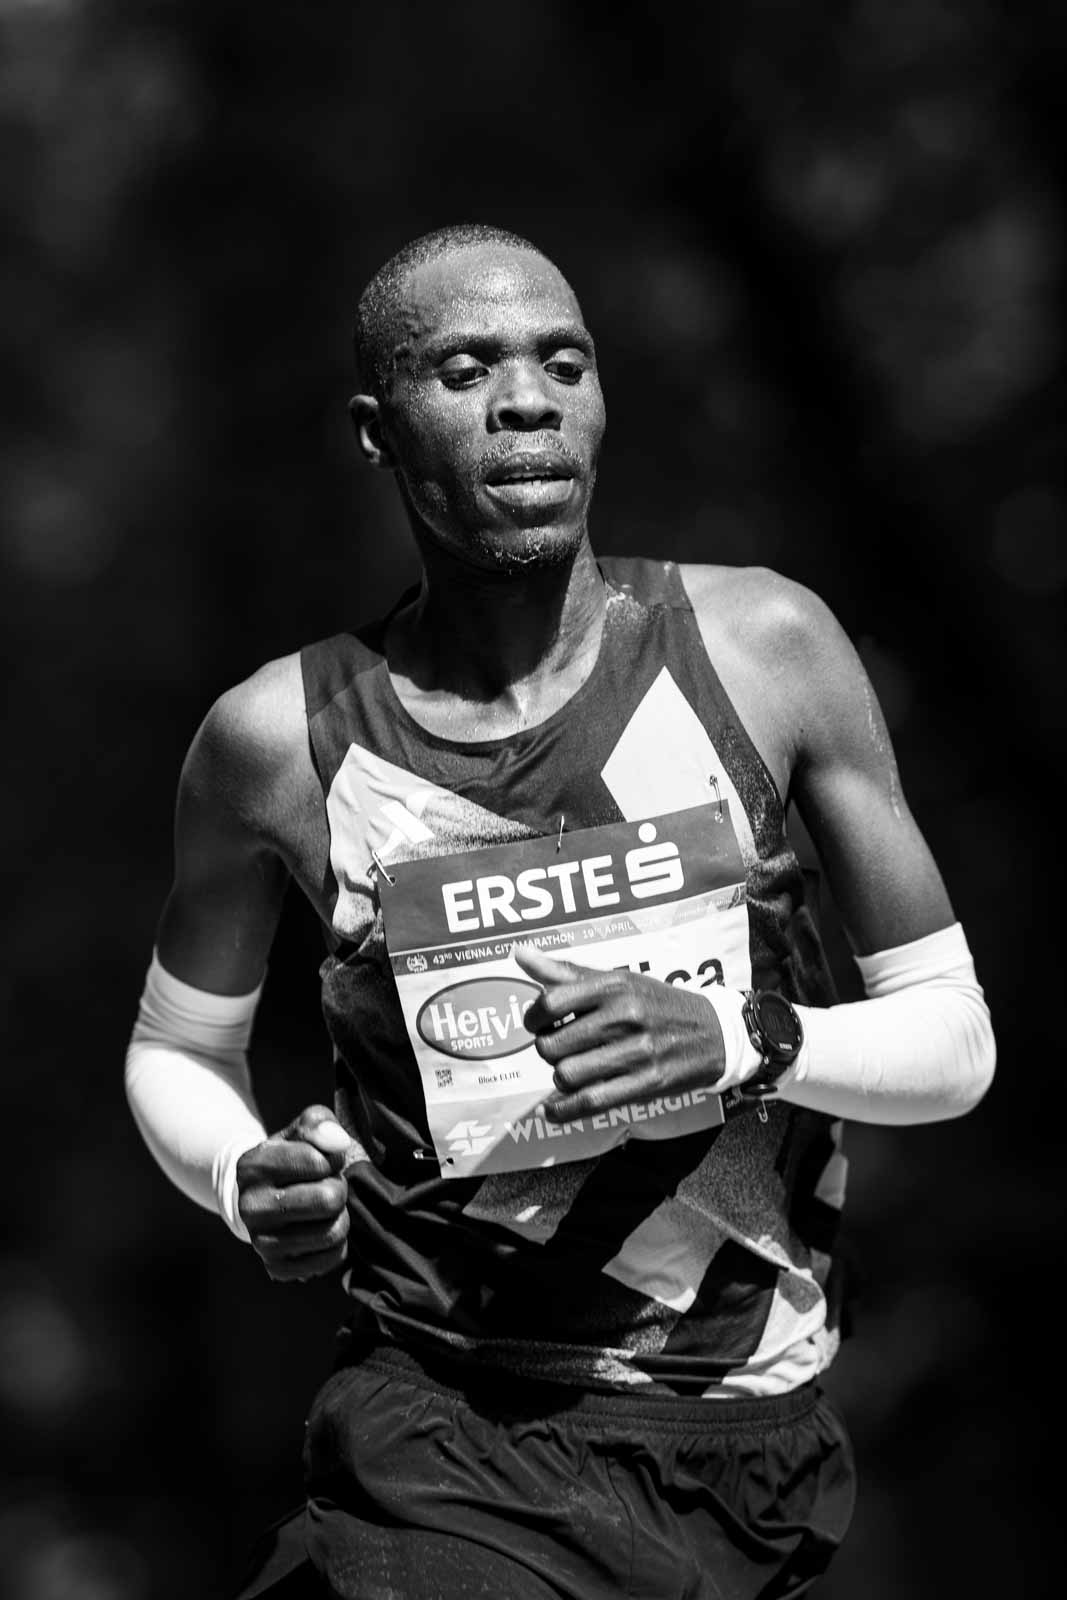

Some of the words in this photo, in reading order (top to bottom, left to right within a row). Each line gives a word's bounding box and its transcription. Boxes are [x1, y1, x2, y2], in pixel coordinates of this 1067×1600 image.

[441, 854, 621, 933] ERSTE
[454, 945, 493, 962] VIENNA
[519, 930, 575, 952] MARATHON
[604, 920, 634, 938] APRIL
[450, 1035, 495, 1052] SPORTS
[504, 1117, 584, 1144] WIEN
